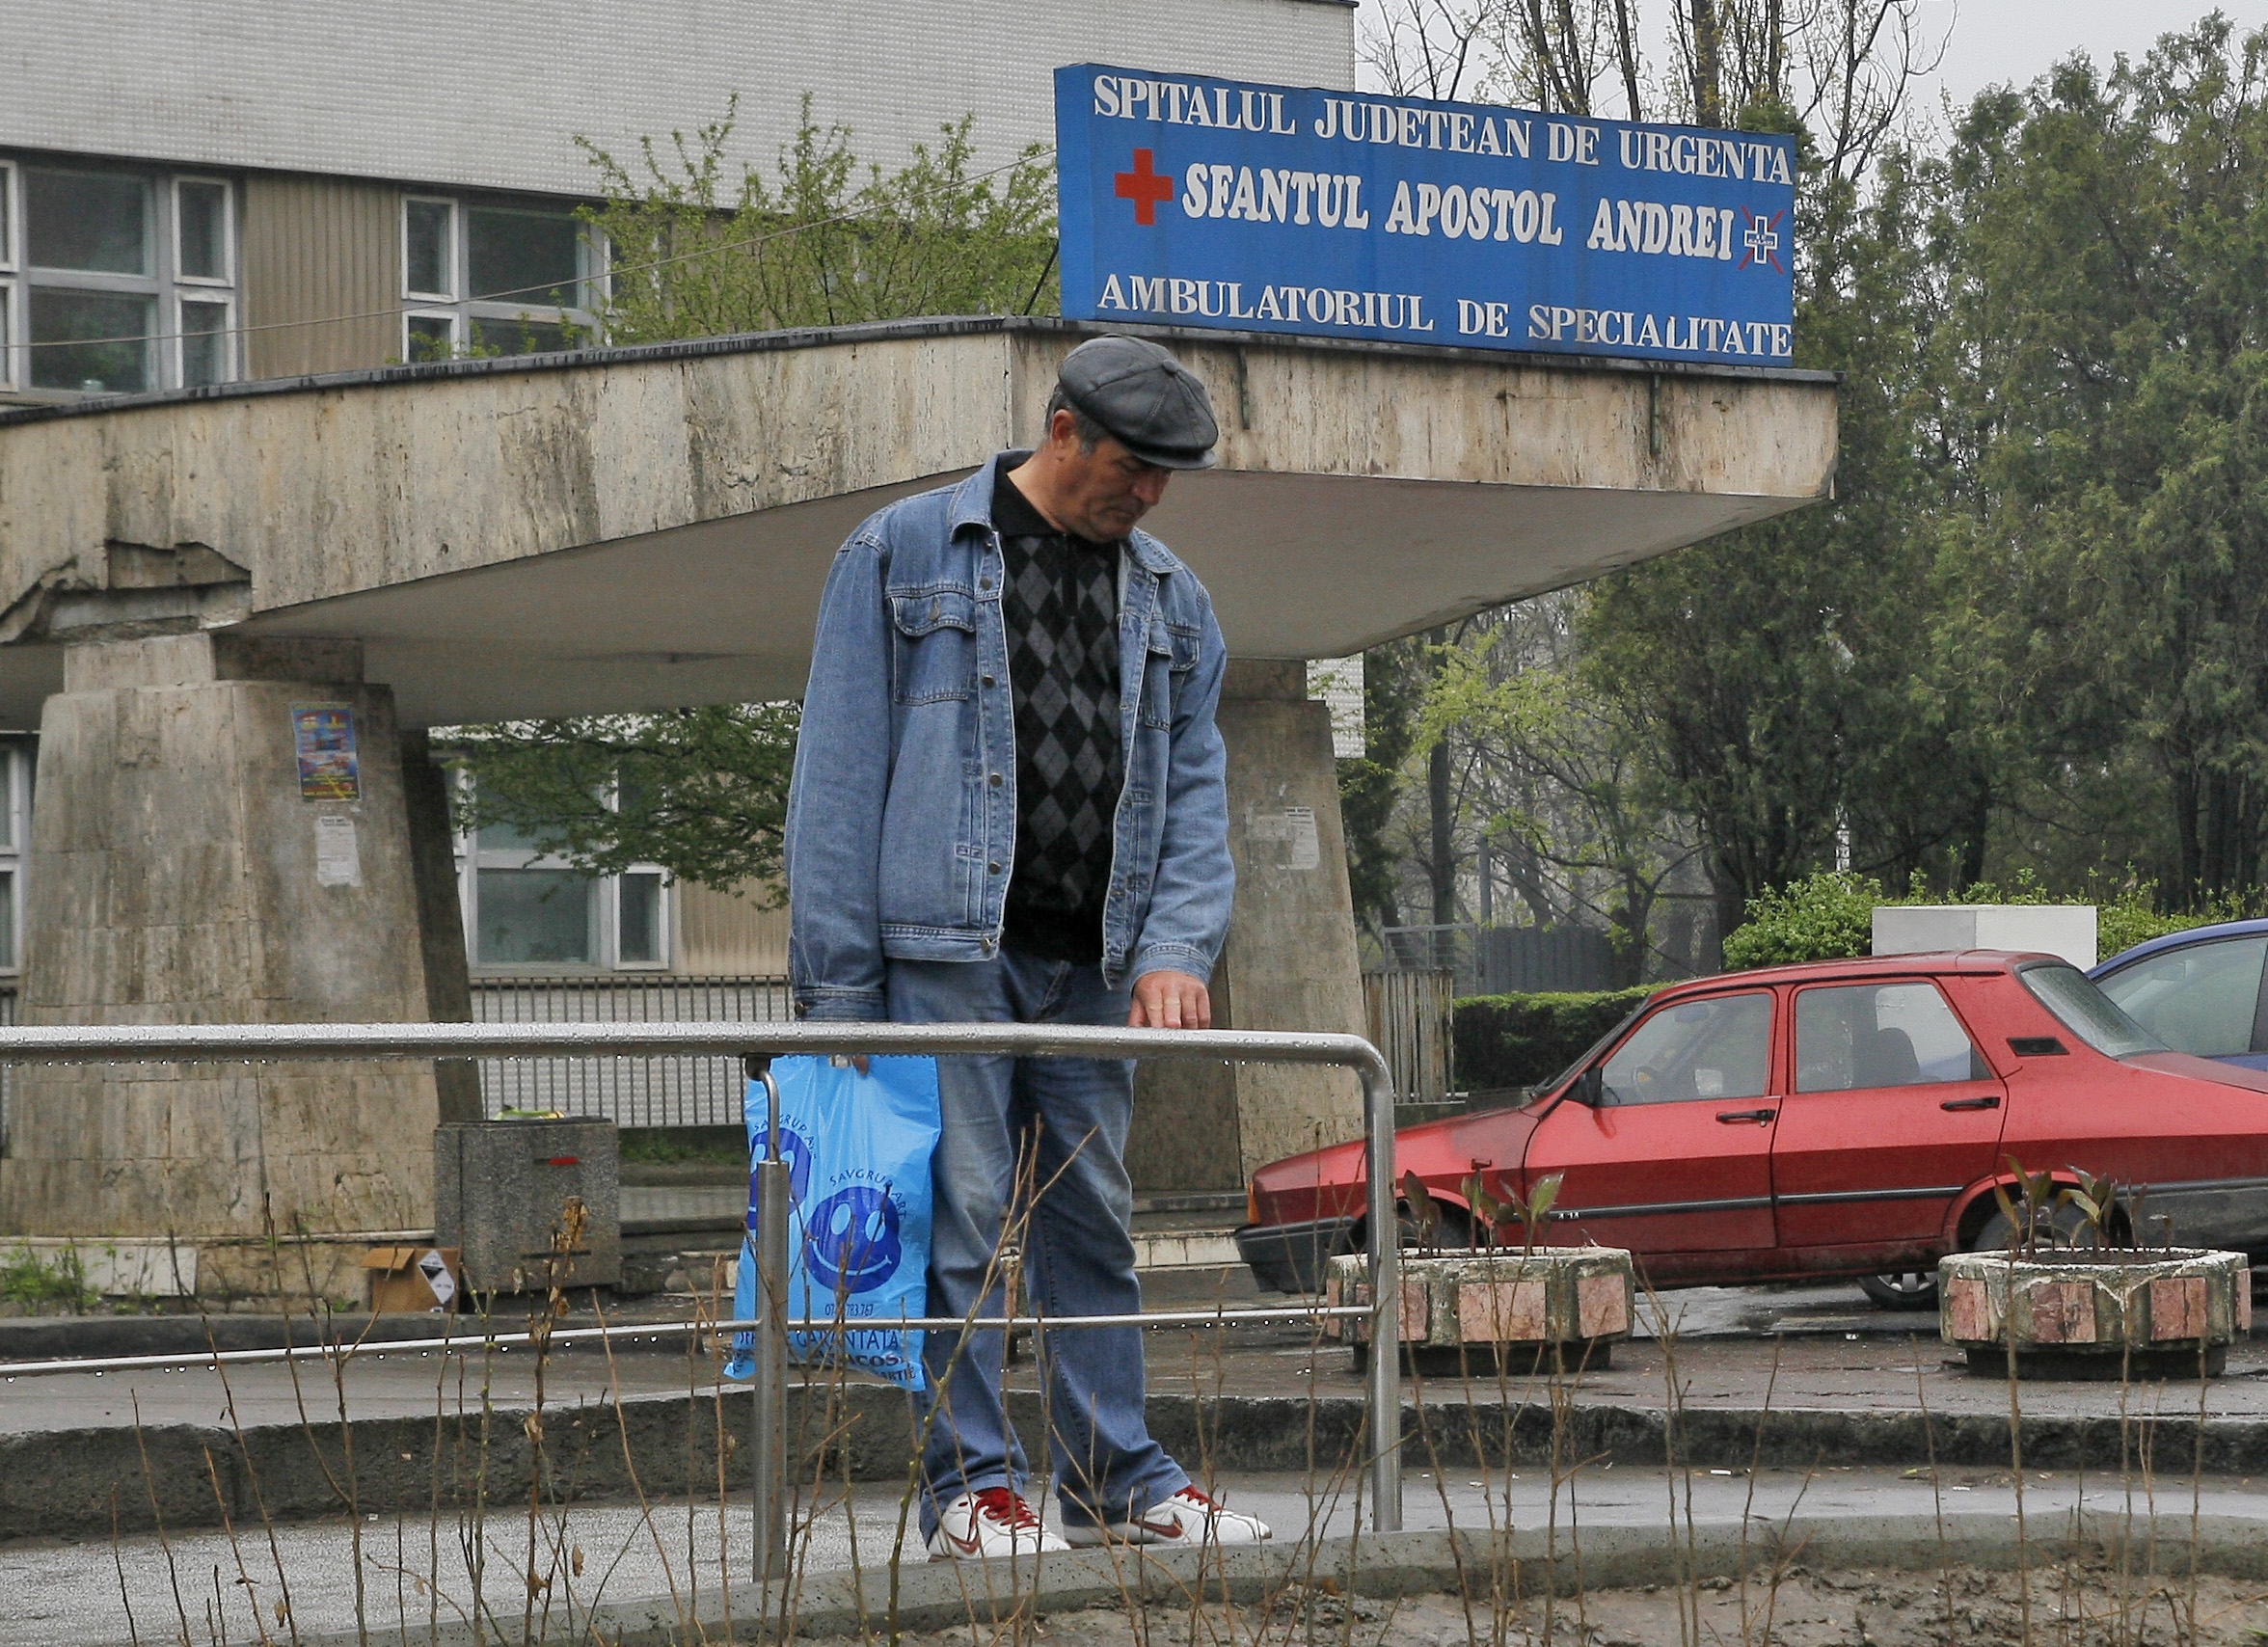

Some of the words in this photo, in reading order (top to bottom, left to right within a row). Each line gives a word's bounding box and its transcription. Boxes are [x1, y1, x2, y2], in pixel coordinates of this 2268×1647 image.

[1094, 74, 1296, 135] SPITALUL
[1314, 98, 1531, 159] JUDETEAN
[1547, 122, 1601, 166] DE
[1618, 129, 1794, 186] URGENTA
[1181, 162, 1370, 230] SFANTUL
[1385, 179, 1563, 246] APOSTOL
[1586, 197, 1735, 261] ANDREI
[1097, 273, 1434, 332] AMBULATORIUL
[1457, 298, 1510, 338] DE
[1527, 304, 1794, 358] SPECIALITATE
